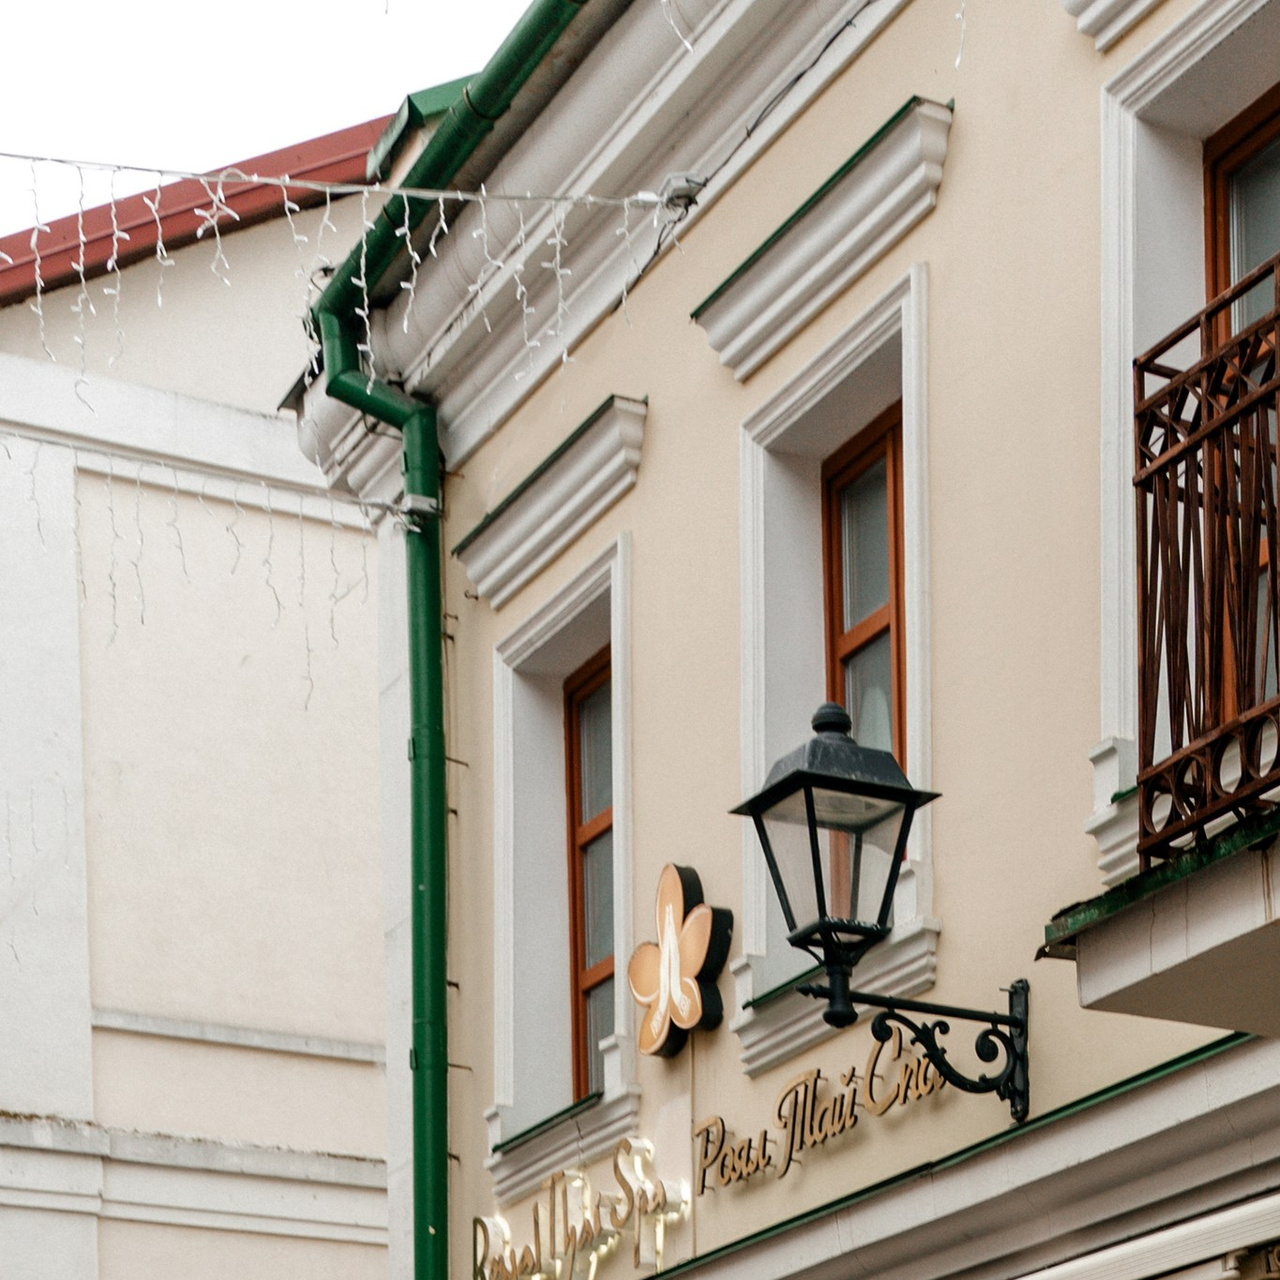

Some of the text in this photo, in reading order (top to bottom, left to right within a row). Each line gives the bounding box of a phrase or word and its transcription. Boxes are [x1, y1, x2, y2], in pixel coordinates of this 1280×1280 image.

[694, 1115, 771, 1196] Роял
[773, 1066, 858, 1179] Тай
[610, 1137, 669, 1269] Spa
